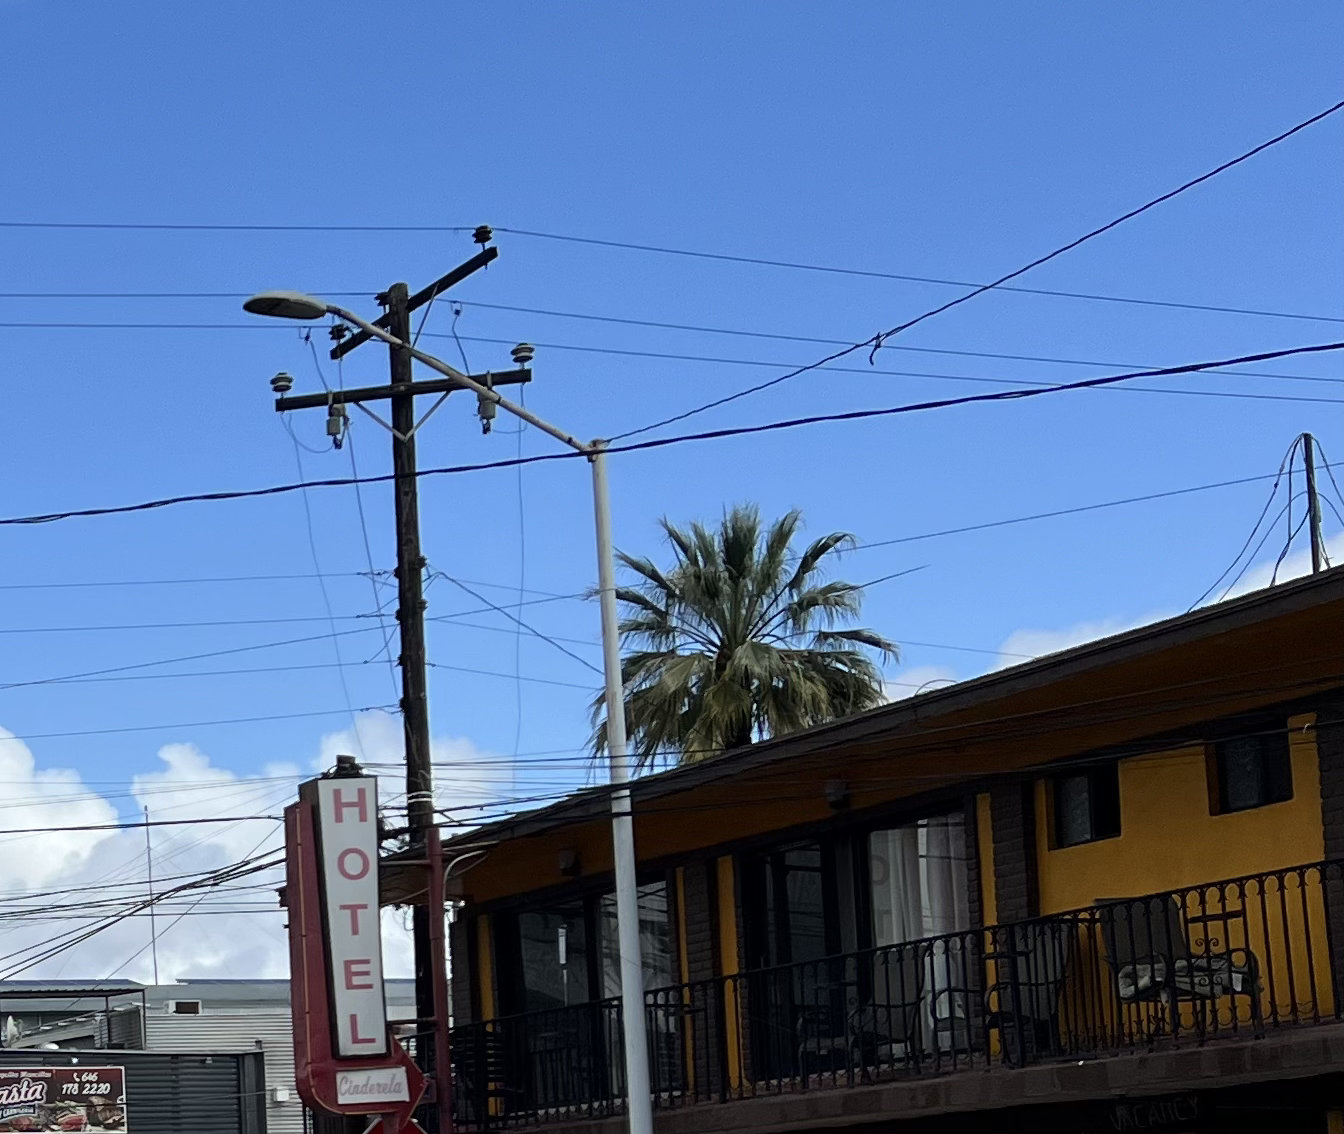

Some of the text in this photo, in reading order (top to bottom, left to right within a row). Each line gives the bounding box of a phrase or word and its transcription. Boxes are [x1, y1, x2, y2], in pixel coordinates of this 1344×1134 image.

[332, 787, 376, 1046] HOTEL
[81, 1071, 99, 1081] 646
[62, 1083, 111, 1095] 178 2220
